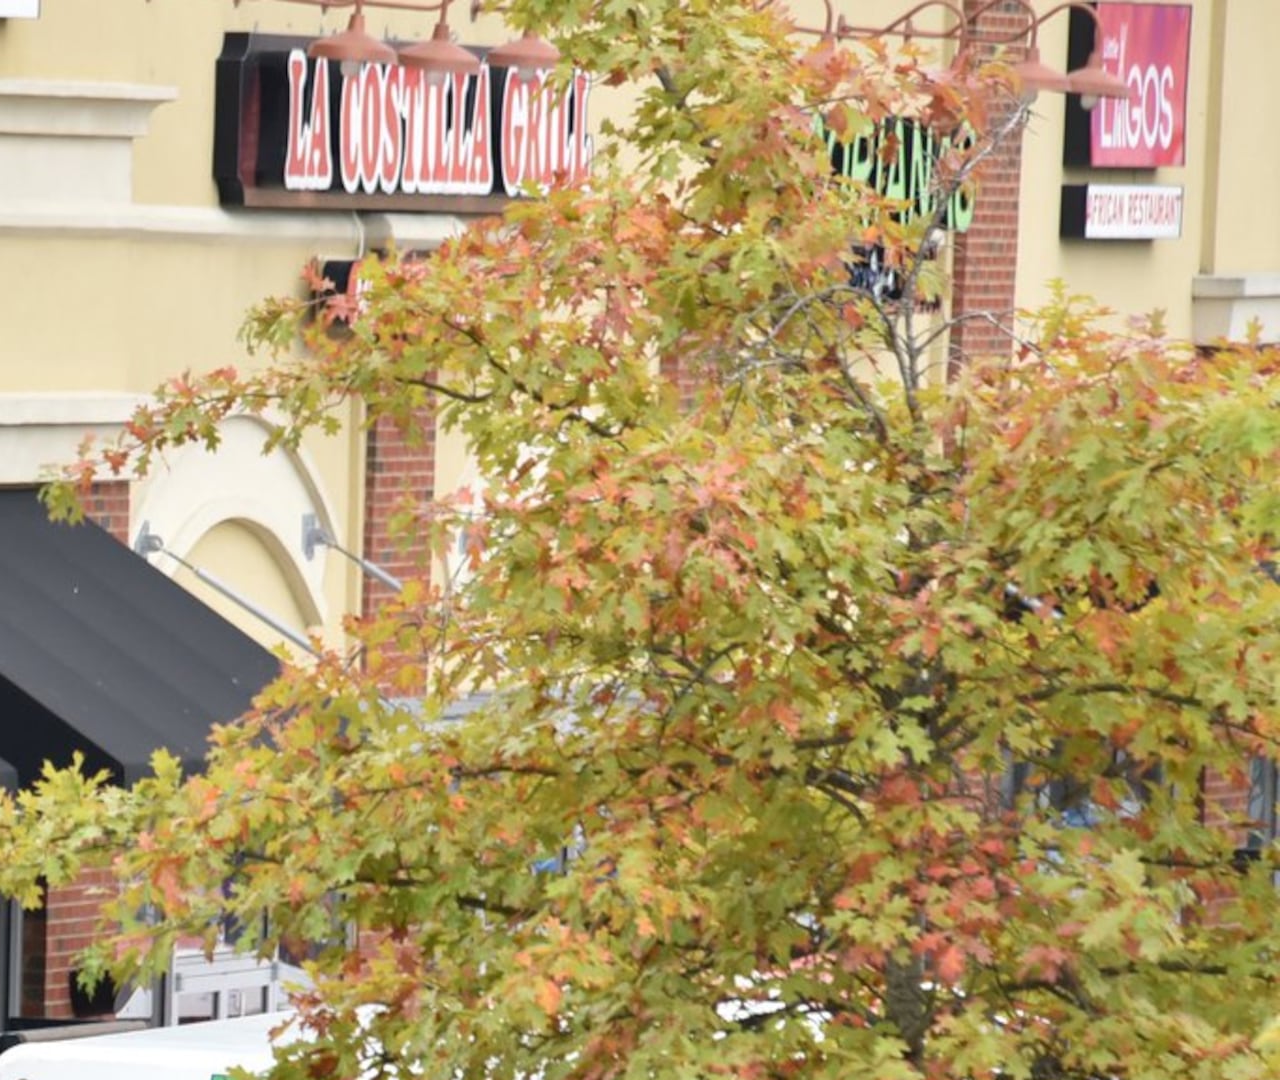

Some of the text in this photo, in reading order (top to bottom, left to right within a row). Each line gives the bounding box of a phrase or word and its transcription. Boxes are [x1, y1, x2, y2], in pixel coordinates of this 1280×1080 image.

[284, 48, 593, 197] LA COSTILLA GRILL
[1100, 30, 1175, 150] LAGOS
[1086, 193, 1182, 226] AFRICAN RESTAURANT
